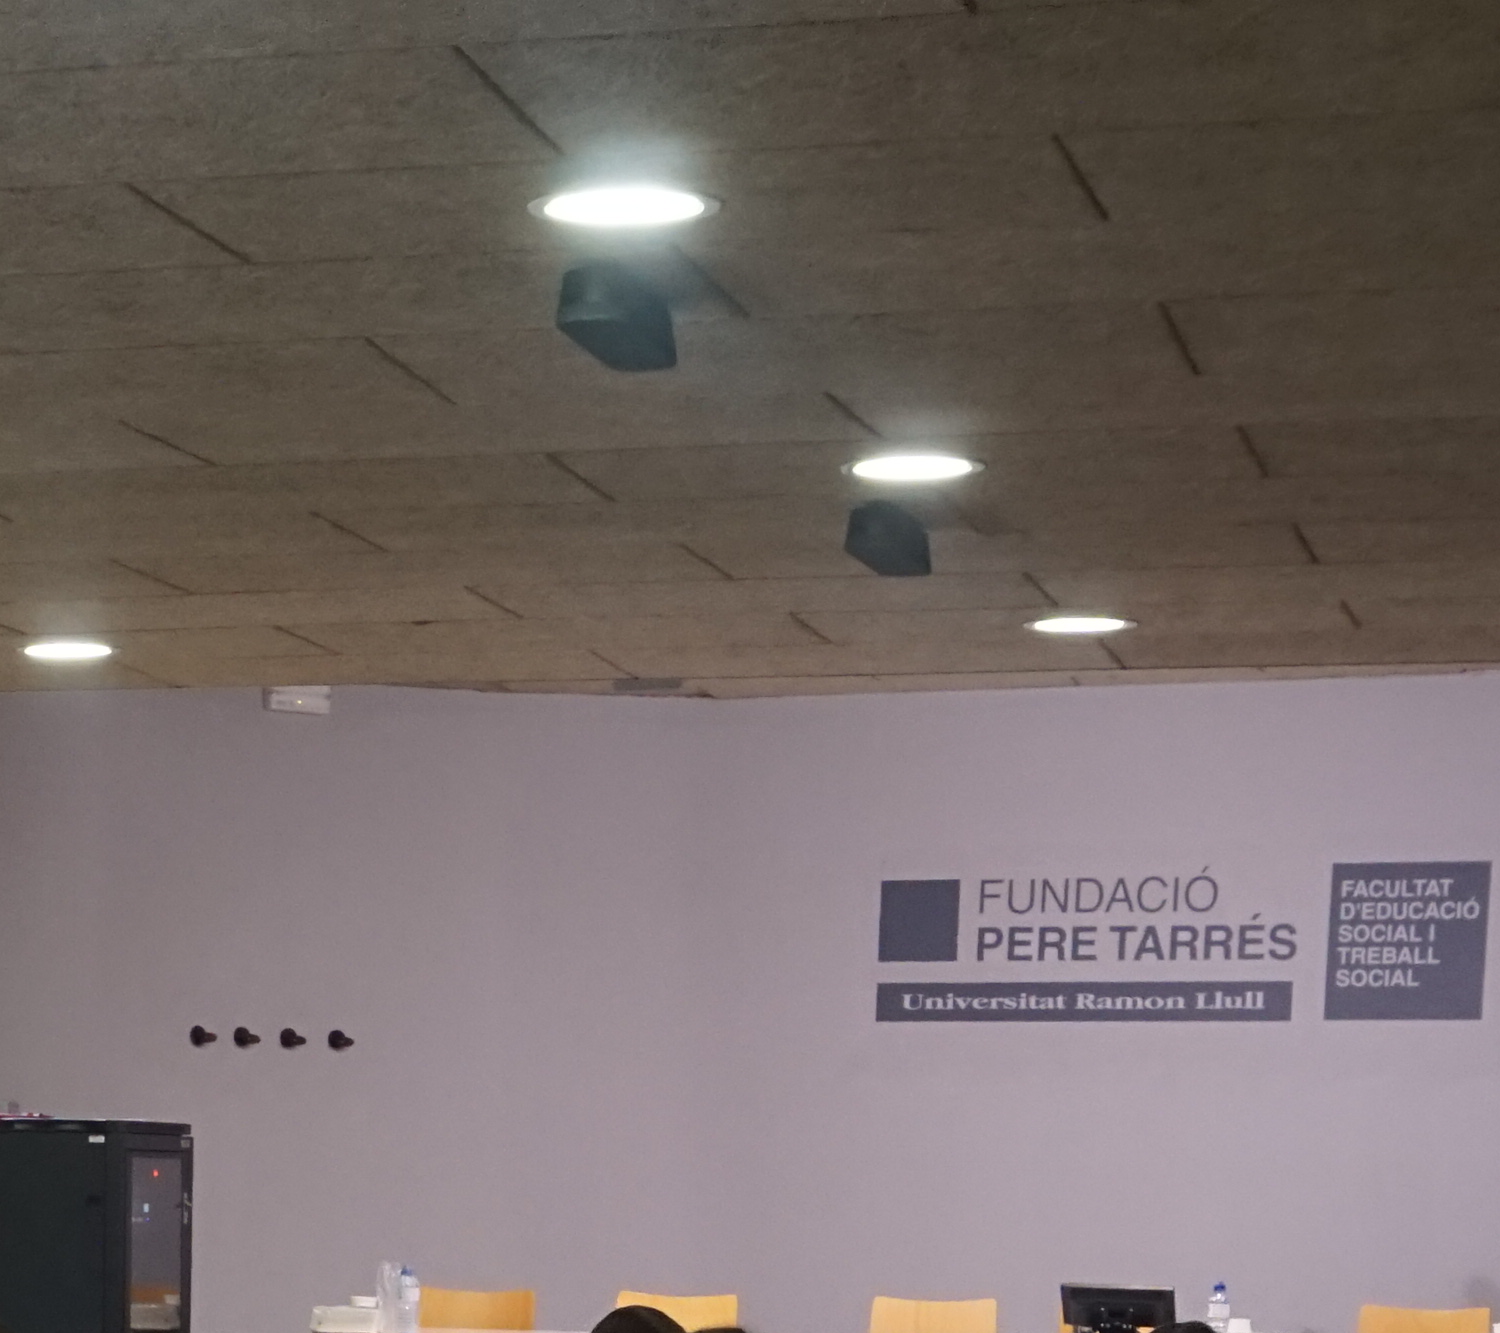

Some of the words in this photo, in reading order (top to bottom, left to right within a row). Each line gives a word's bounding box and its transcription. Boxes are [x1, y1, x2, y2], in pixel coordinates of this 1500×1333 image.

[979, 866, 1219, 914] FUNDACIÓ
[1341, 879, 1454, 898] FACULTAT
[1340, 896, 1480, 920] D'EDUCACIÓ
[976, 926, 1098, 961] PERE
[1110, 913, 1297, 961] TARRÉS
[1338, 924, 1422, 943] SOCIAL
[1428, 924, 1435, 942] I
[1336, 946, 1440, 965] TREBALL
[1335, 968, 1420, 987] SOCIAL
[902, 992, 1065, 1011] Universitat
[1075, 992, 1185, 1011] Ramon
[1195, 991, 1264, 1010] Llull
